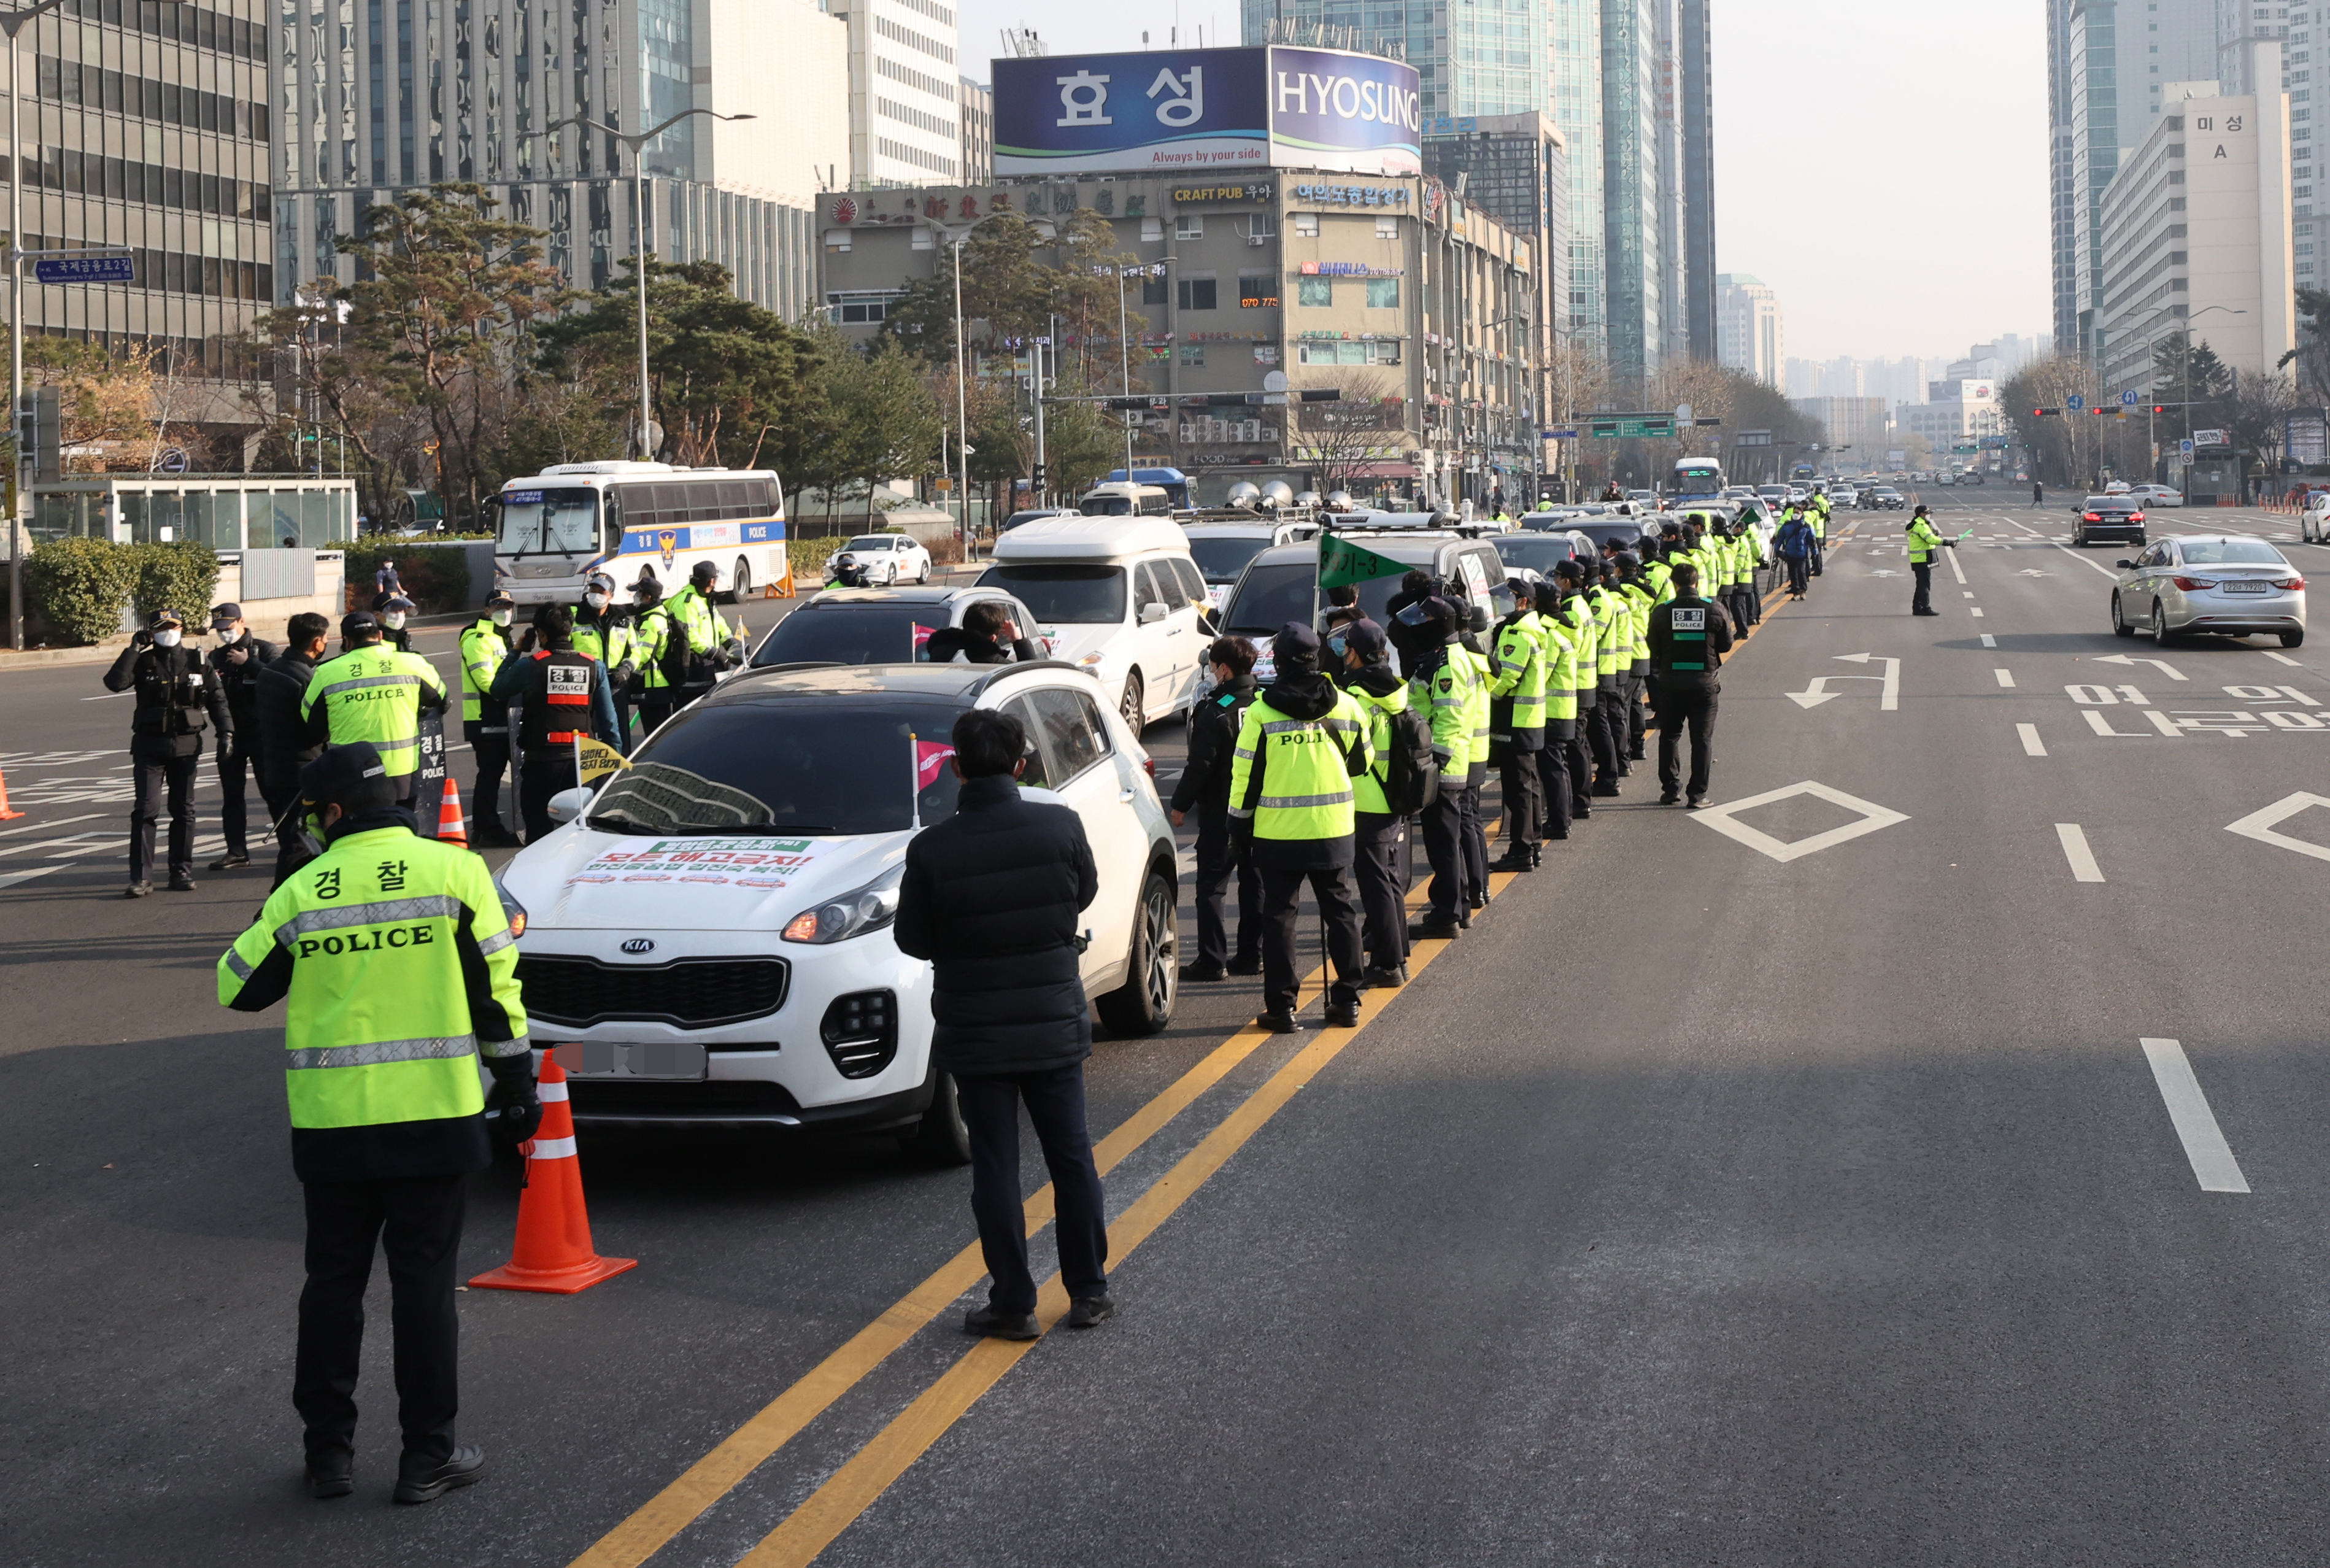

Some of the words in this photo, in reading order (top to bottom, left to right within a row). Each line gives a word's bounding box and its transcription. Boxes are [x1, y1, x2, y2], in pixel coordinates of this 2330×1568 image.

[1056, 66, 1204, 128] 효성
[1277, 71, 1419, 132] HYOSUNG
[2197, 116, 2242, 132] 미성
[1153, 152, 1193, 164] Always
[1197, 150, 1209, 163] by
[1211, 151, 1235, 162] your
[1238, 148, 1260, 159] side
[2213, 144, 2227, 158] A
[1175, 188, 1215, 201] CRAFT
[1217, 187, 1243, 199] PUB
[1298, 184, 1411, 204] 여의도종합상가
[58, 259, 131, 273] 국제금융로2길
[1242, 298, 1259, 307] 070
[749, 527, 766, 538] POLICE
[1676, 611, 1701, 620] 경찰
[350, 660, 392, 677] 경찰
[552, 670, 585, 682] 경찰
[345, 688, 404, 703] POLICE
[421, 734, 442, 754] 경찰
[423, 767, 444, 779] POLICE
[596, 852, 667, 862] 모든
[314, 860, 408, 900] 경찰
[298, 925, 433, 959] POLICE
[624, 940, 649, 951] KIA
